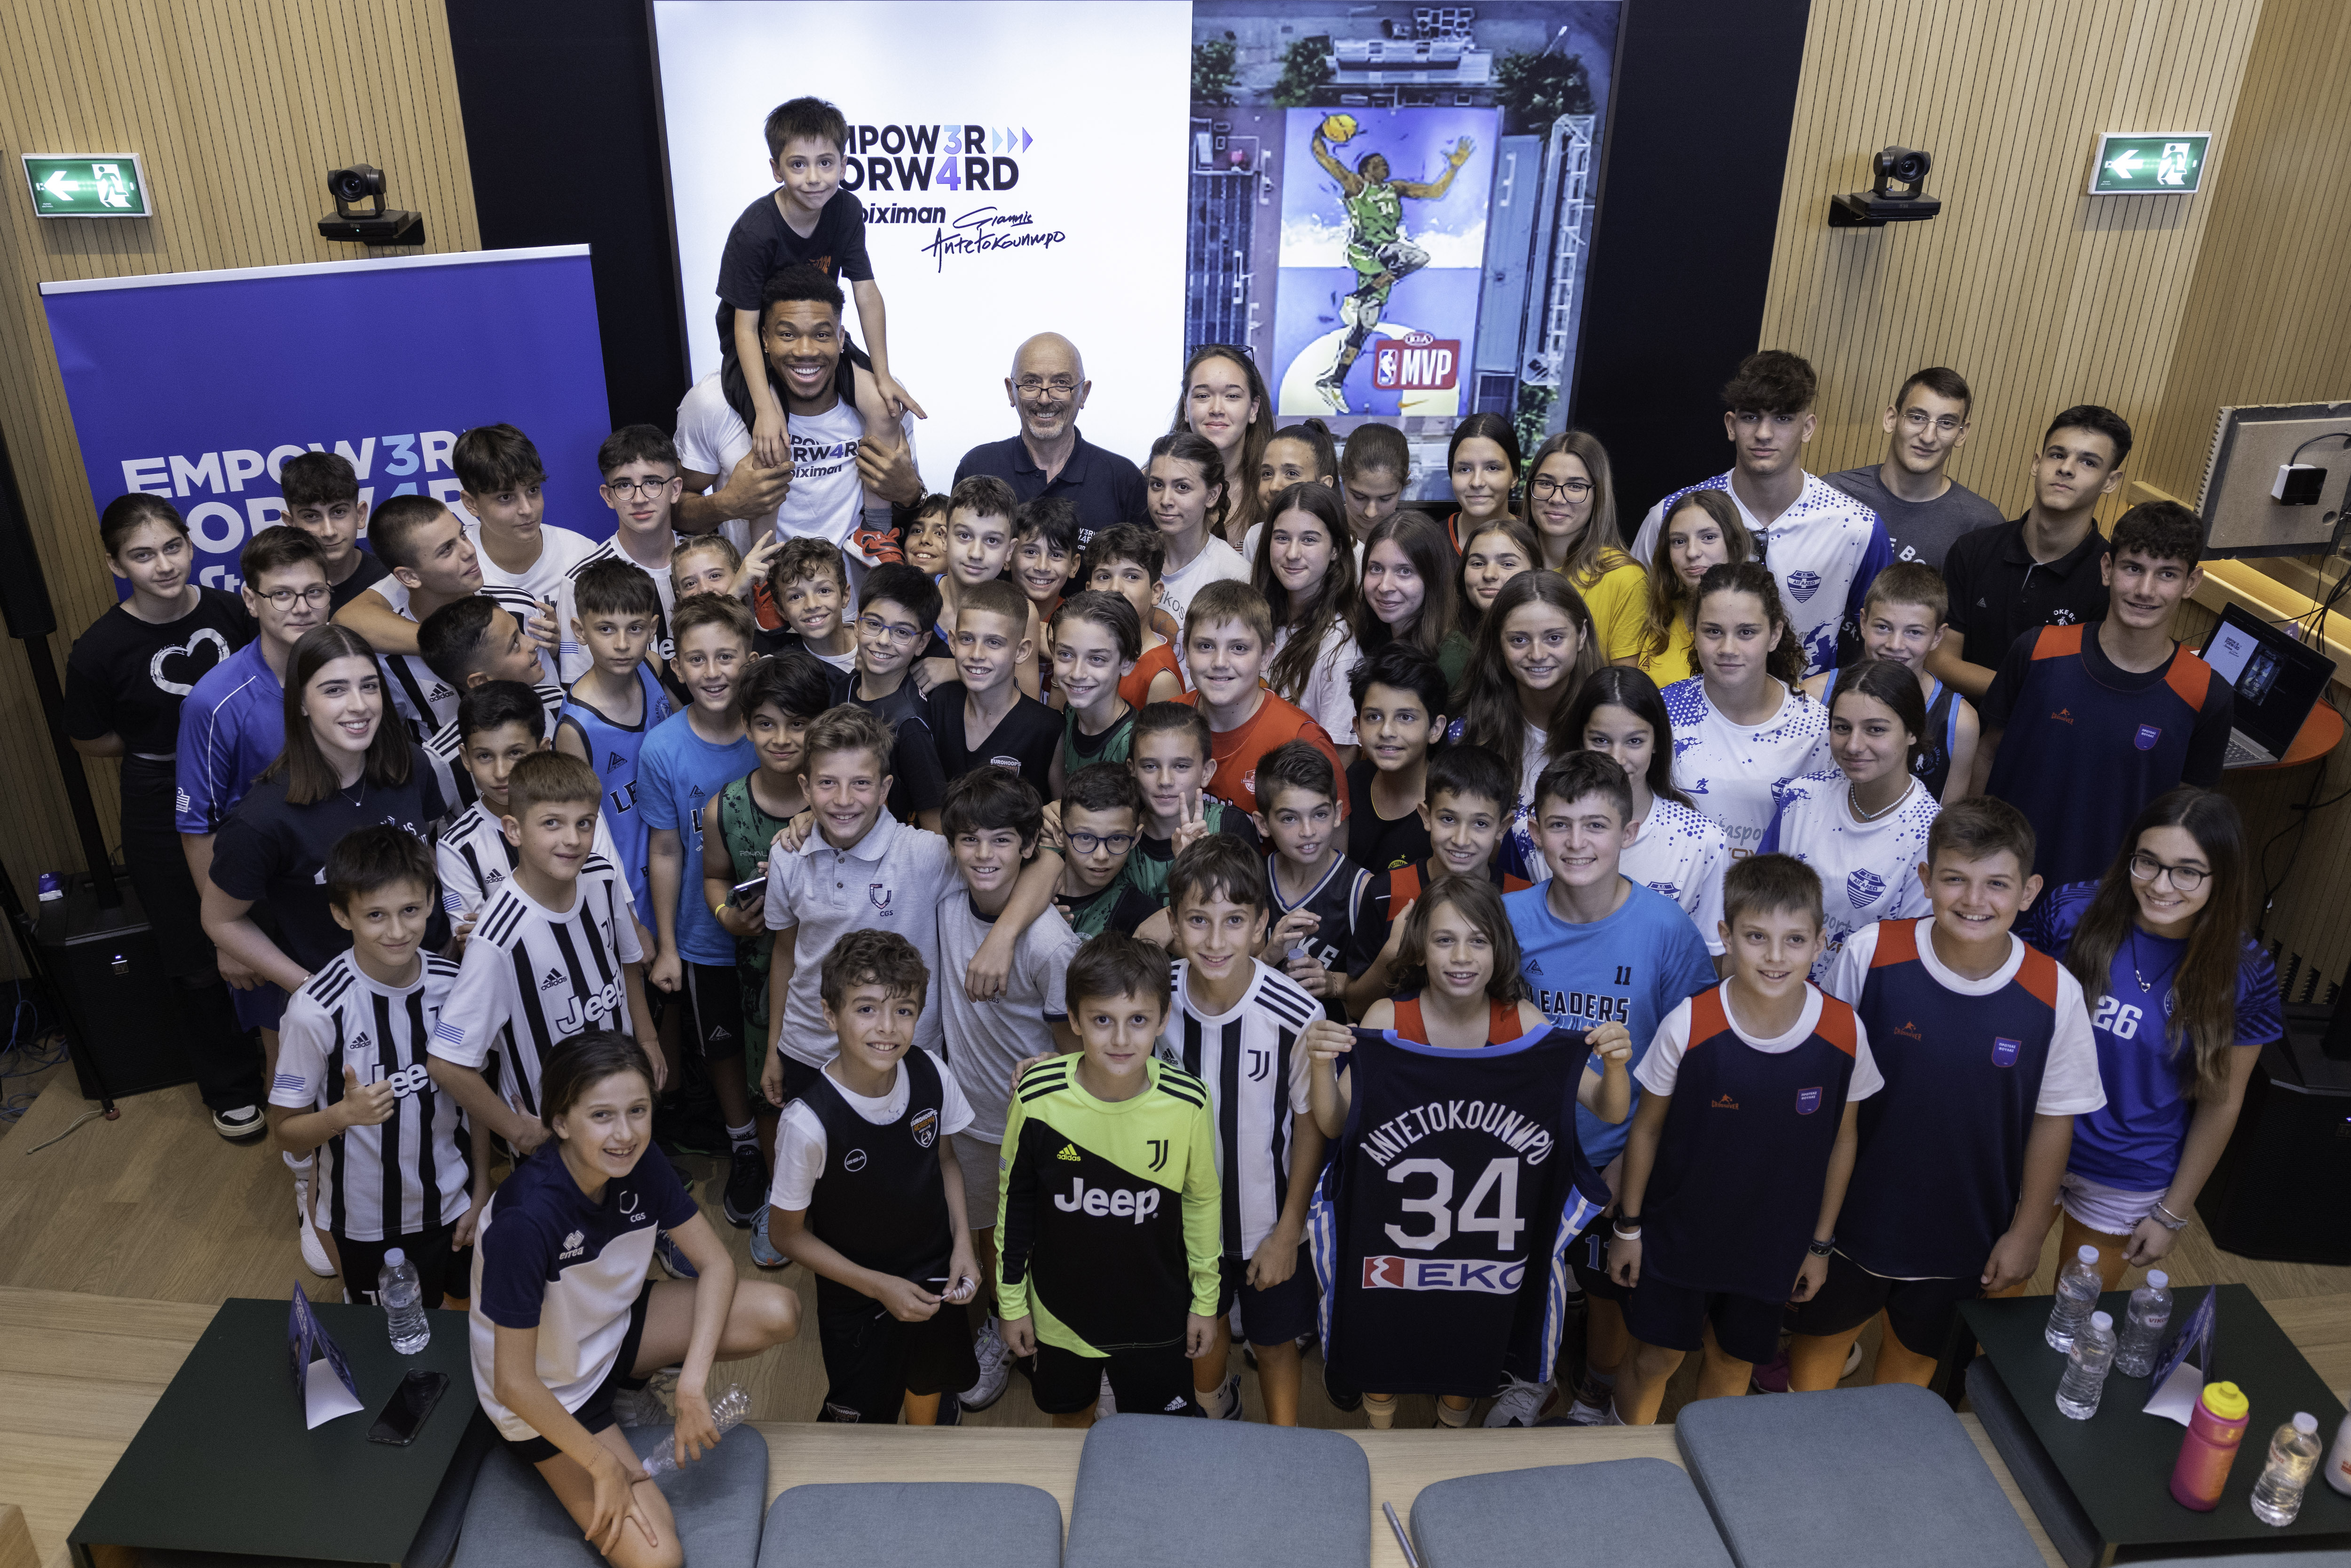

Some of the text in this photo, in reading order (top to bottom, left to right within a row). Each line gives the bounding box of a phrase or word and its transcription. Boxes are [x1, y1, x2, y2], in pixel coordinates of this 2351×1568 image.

[844, 124, 986, 155] MPOW3R
[839, 156, 1019, 192] ORW4RD
[1400, 349, 1452, 386] MVP
[428, 692, 454, 703] adidas
[541, 976, 568, 991] adidas
[1614, 966, 1632, 986] 11
[2092, 995, 2143, 1040] 26
[349, 1040, 371, 1049] adidas
[910, 1110, 938, 1127] EUROHOOPS
[914, 1115, 935, 1132] ACADEMY
[1360, 1100, 1554, 1167] ANTETOKOUNMPO
[846, 1156, 865, 1166] GSA
[1057, 1153, 1081, 1162] adidas
[1054, 1177, 1160, 1225] Jeep
[1385, 1157, 1525, 1251] 34
[630, 1213, 646, 1223] CGS
[1164, 1401, 1187, 1411] adidas
